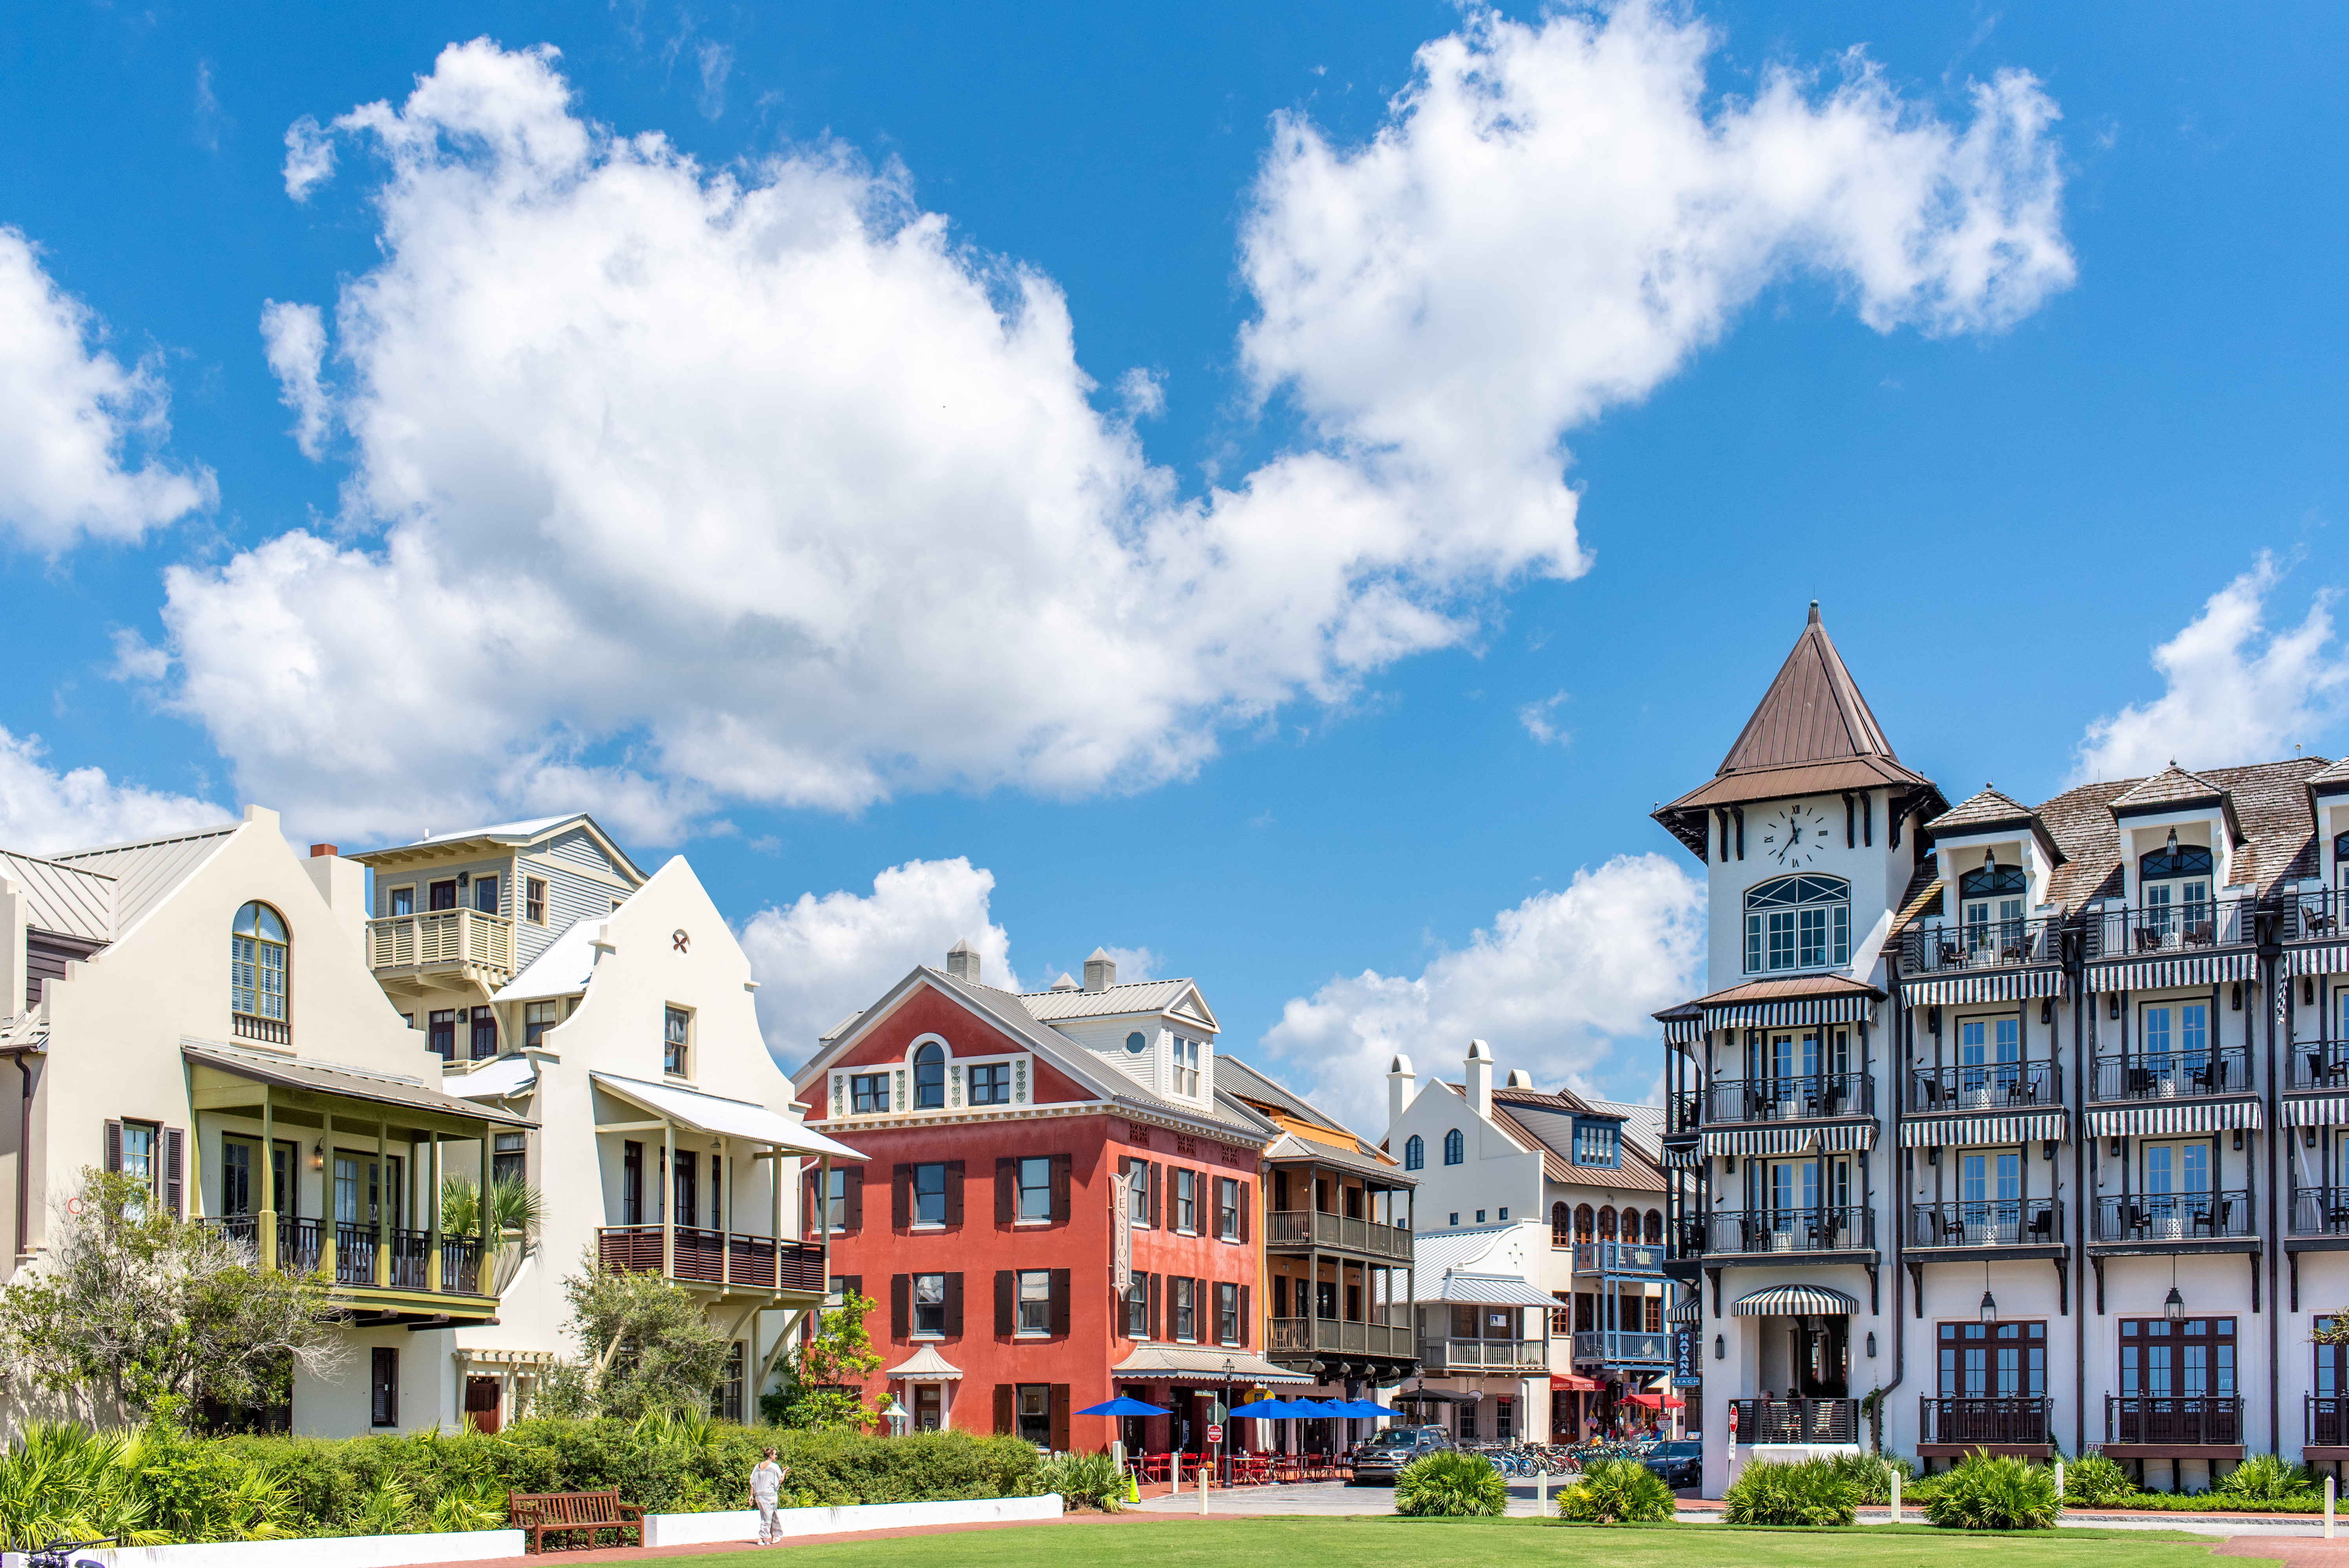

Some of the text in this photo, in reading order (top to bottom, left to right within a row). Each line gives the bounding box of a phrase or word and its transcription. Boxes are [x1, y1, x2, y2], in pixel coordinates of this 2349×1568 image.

[1791, 805, 1800, 815] XII
[1792, 859, 1799, 868] VI
[1117, 1186, 1127, 1283] PENSIONE
[1678, 1333, 1690, 1376] HAVANA
